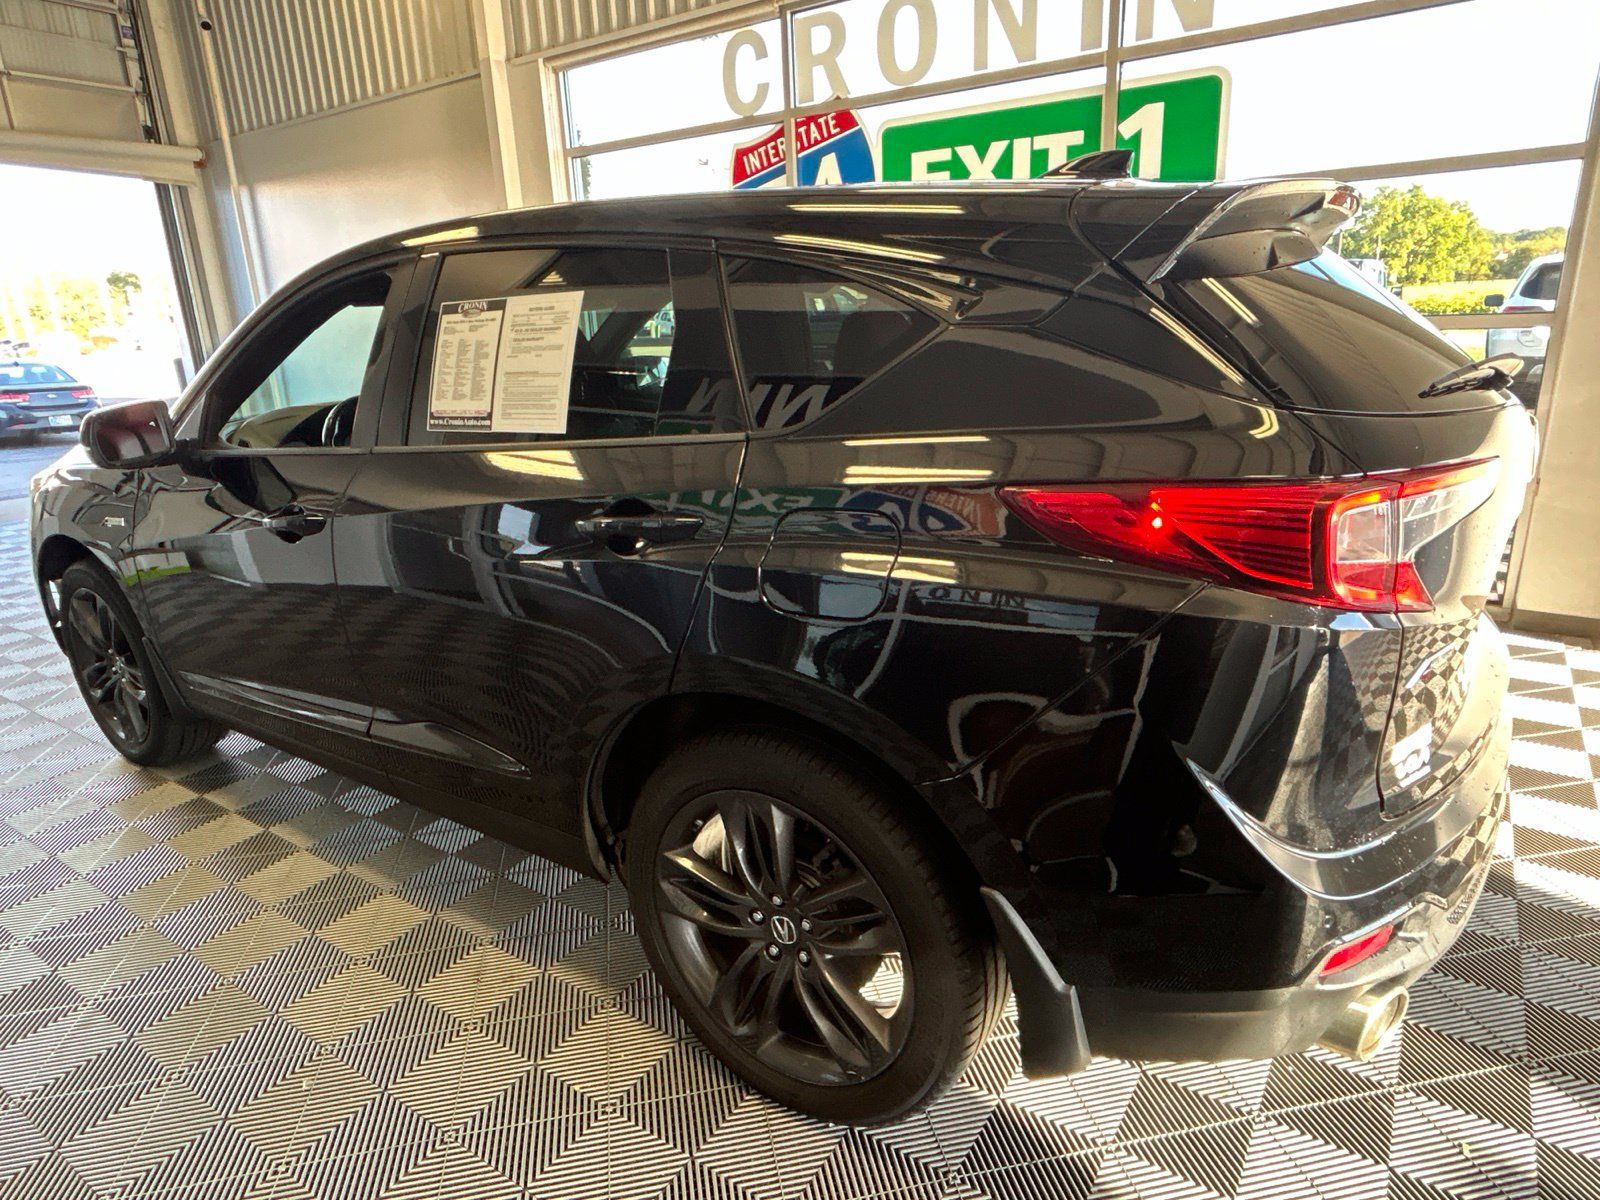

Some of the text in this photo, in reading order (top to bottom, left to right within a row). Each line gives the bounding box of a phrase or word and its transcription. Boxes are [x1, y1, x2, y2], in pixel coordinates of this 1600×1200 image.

[743, 112, 842, 176] INTERTATE
[911, 130, 1084, 180] EXIT
[429, 417, 491, 426] www.CroninAuto.com
